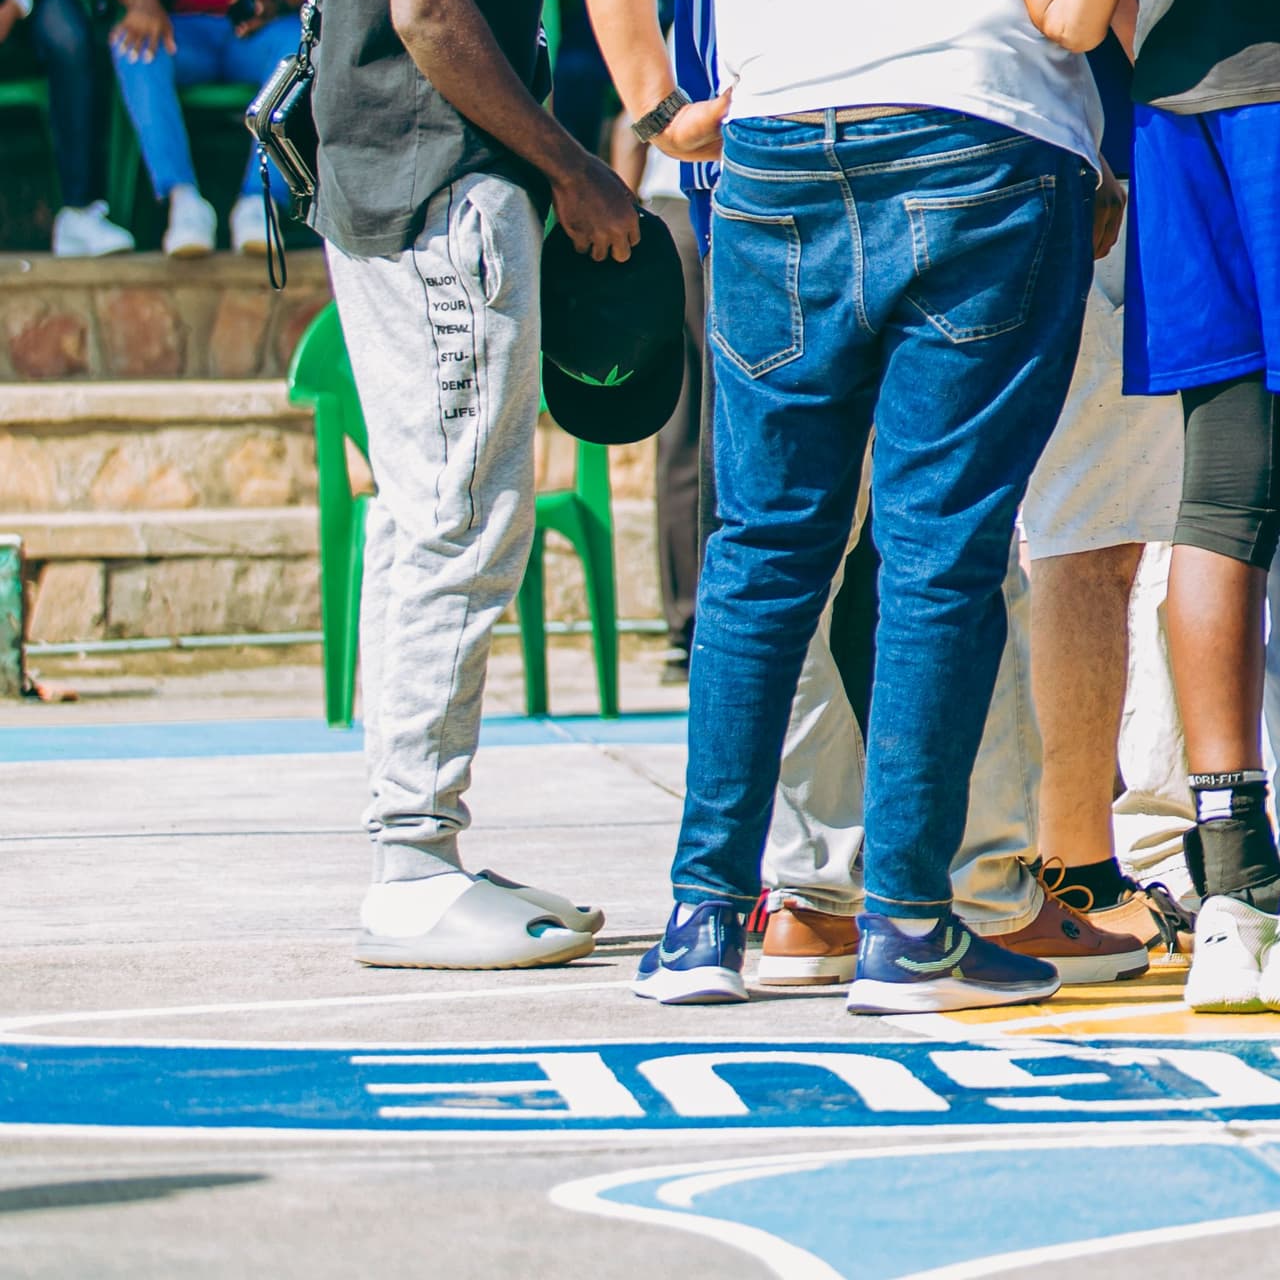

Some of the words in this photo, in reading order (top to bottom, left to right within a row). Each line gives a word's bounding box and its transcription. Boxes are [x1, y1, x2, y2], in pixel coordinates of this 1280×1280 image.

[426, 275, 458, 287] ENJOY
[433, 300, 467, 311] YOUR
[441, 351, 469, 363] STU-
[442, 378, 473, 390] DENT
[444, 407, 477, 419] LIFE
[1195, 772, 1241, 786] DRI-FIT
